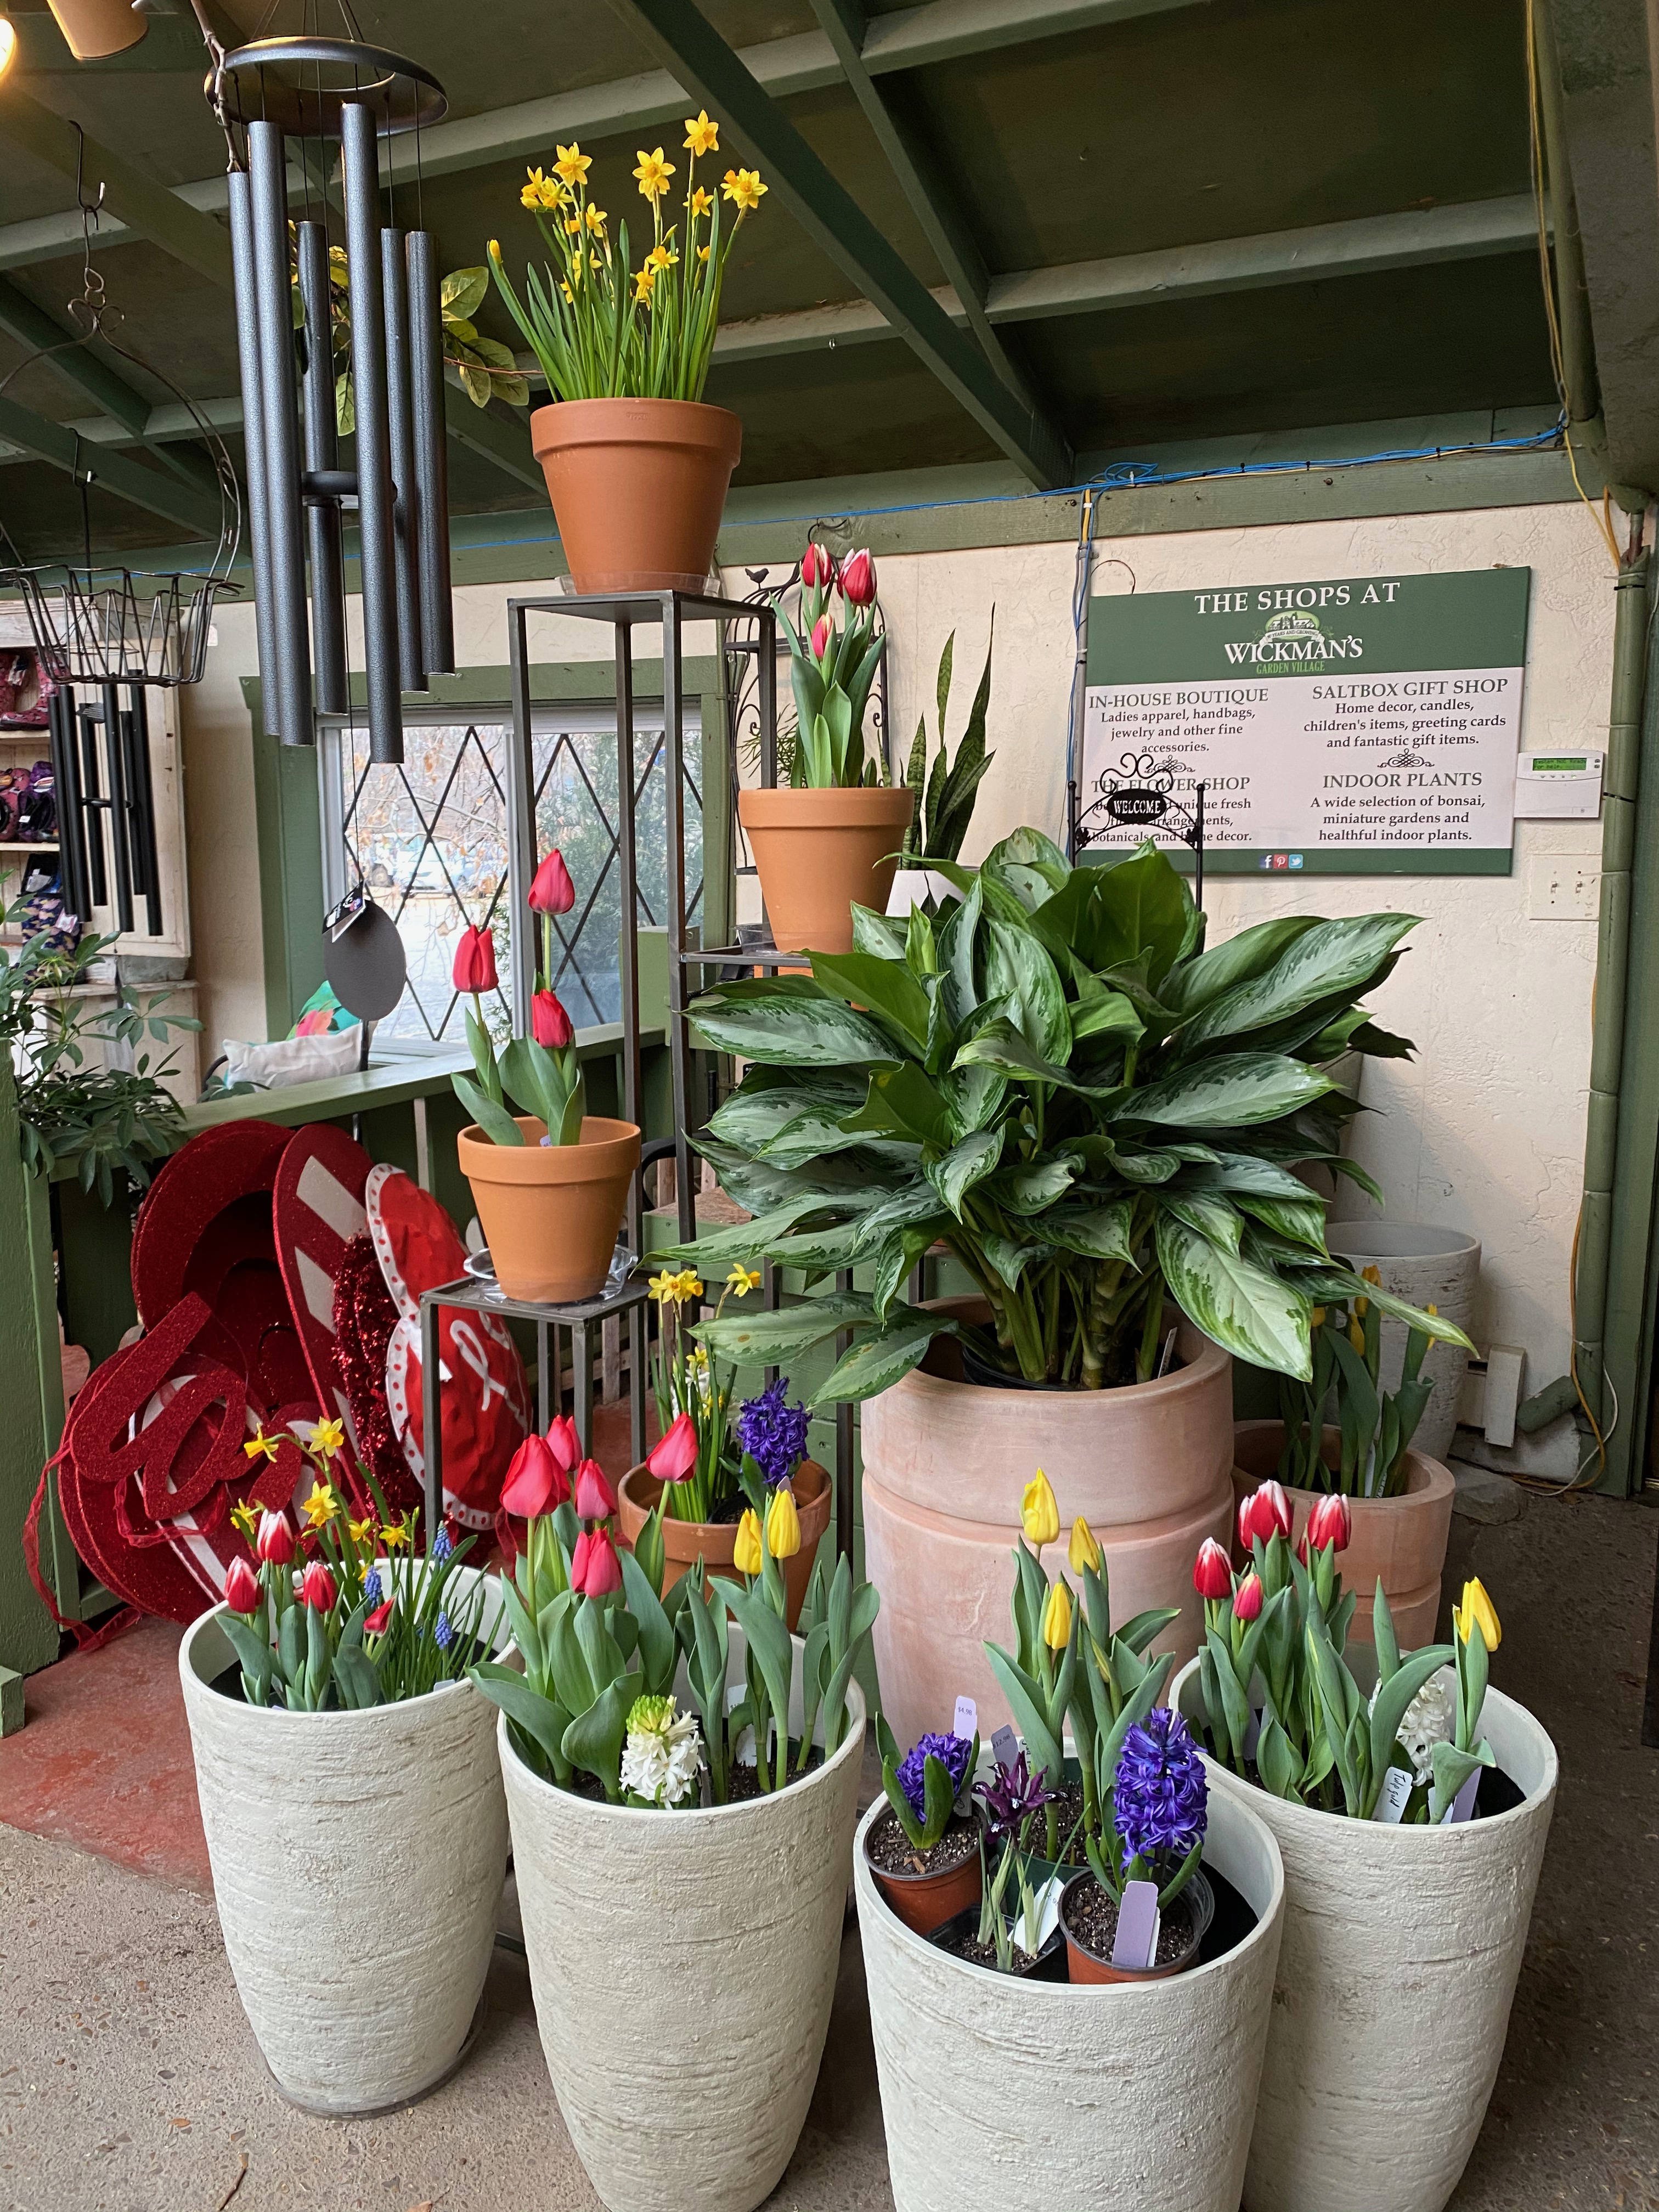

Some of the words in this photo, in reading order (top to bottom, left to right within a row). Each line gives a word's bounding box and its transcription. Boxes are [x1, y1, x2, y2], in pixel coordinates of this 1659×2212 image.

[1194, 592, 1248, 614] THE
[1258, 585, 1351, 610] SHOPS
[1360, 582, 1401, 604] AT
[1224, 635, 1364, 664] WICKMAN'S
[1256, 663, 1290, 674] GARDEN
[1292, 661, 1325, 672] VILLAGE
[1312, 683, 1400, 699] SALTBOX
[1403, 681, 1448, 696] GIFT
[1453, 678, 1508, 694] SHOP
[1089, 693, 1172, 708] IN-HOUSE
[1176, 689, 1268, 705] BOUTIQUE
[1335, 703, 1374, 714] Home
[1378, 701, 1417, 713] decor,
[1420, 699, 1474, 712] candles,
[1102, 712, 1138, 723] Ladies
[1142, 709, 1190, 723] apparel,
[1193, 707, 1256, 720] handbags,
[1304, 719, 1366, 731] children's
[1370, 719, 1408, 731] items,
[1412, 716, 1467, 731] greeting
[1470, 715, 1506, 726] cards
[1110, 727, 1154, 741] jewelry
[1158, 726, 1180, 736] and
[1184, 724, 1216, 736] other
[1218, 724, 1243, 735] fine
[1142, 742, 1210, 753] accessories.
[1327, 736, 1350, 747] and
[1354, 735, 1409, 747] fantastic
[1412, 734, 1436, 748] gift
[1440, 733, 1479, 745] items.
[1091, 780, 1124, 793] THE
[1128, 778, 1197, 792] FLOWER
[1203, 777, 1250, 791] SHOP
[1323, 774, 1402, 788] INDOOR
[1407, 772, 1482, 786] PLANTS
[1113, 800, 1161, 814] WELCOME
[1176, 799, 1217, 809] uniue
[1221, 798, 1251, 809] fresh
[1310, 797, 1320, 808] A
[1325, 796, 1356, 808] wide
[1359, 796, 1416, 807] selection
[1420, 795, 1434, 806] of
[1437, 795, 1485, 808] bonsai,
[1323, 813, 1386, 824] miniature
[1389, 812, 1441, 827] gardens
[1444, 812, 1470, 823] and
[1155, 832, 1176, 842] and
[1217, 831, 1252, 841] decor.
[1318, 829, 1377, 840] healthful
[1381, 829, 1425, 840] indoor
[1428, 829, 1472, 843] plants.
[958, 1707, 972, 1716] $4.98
